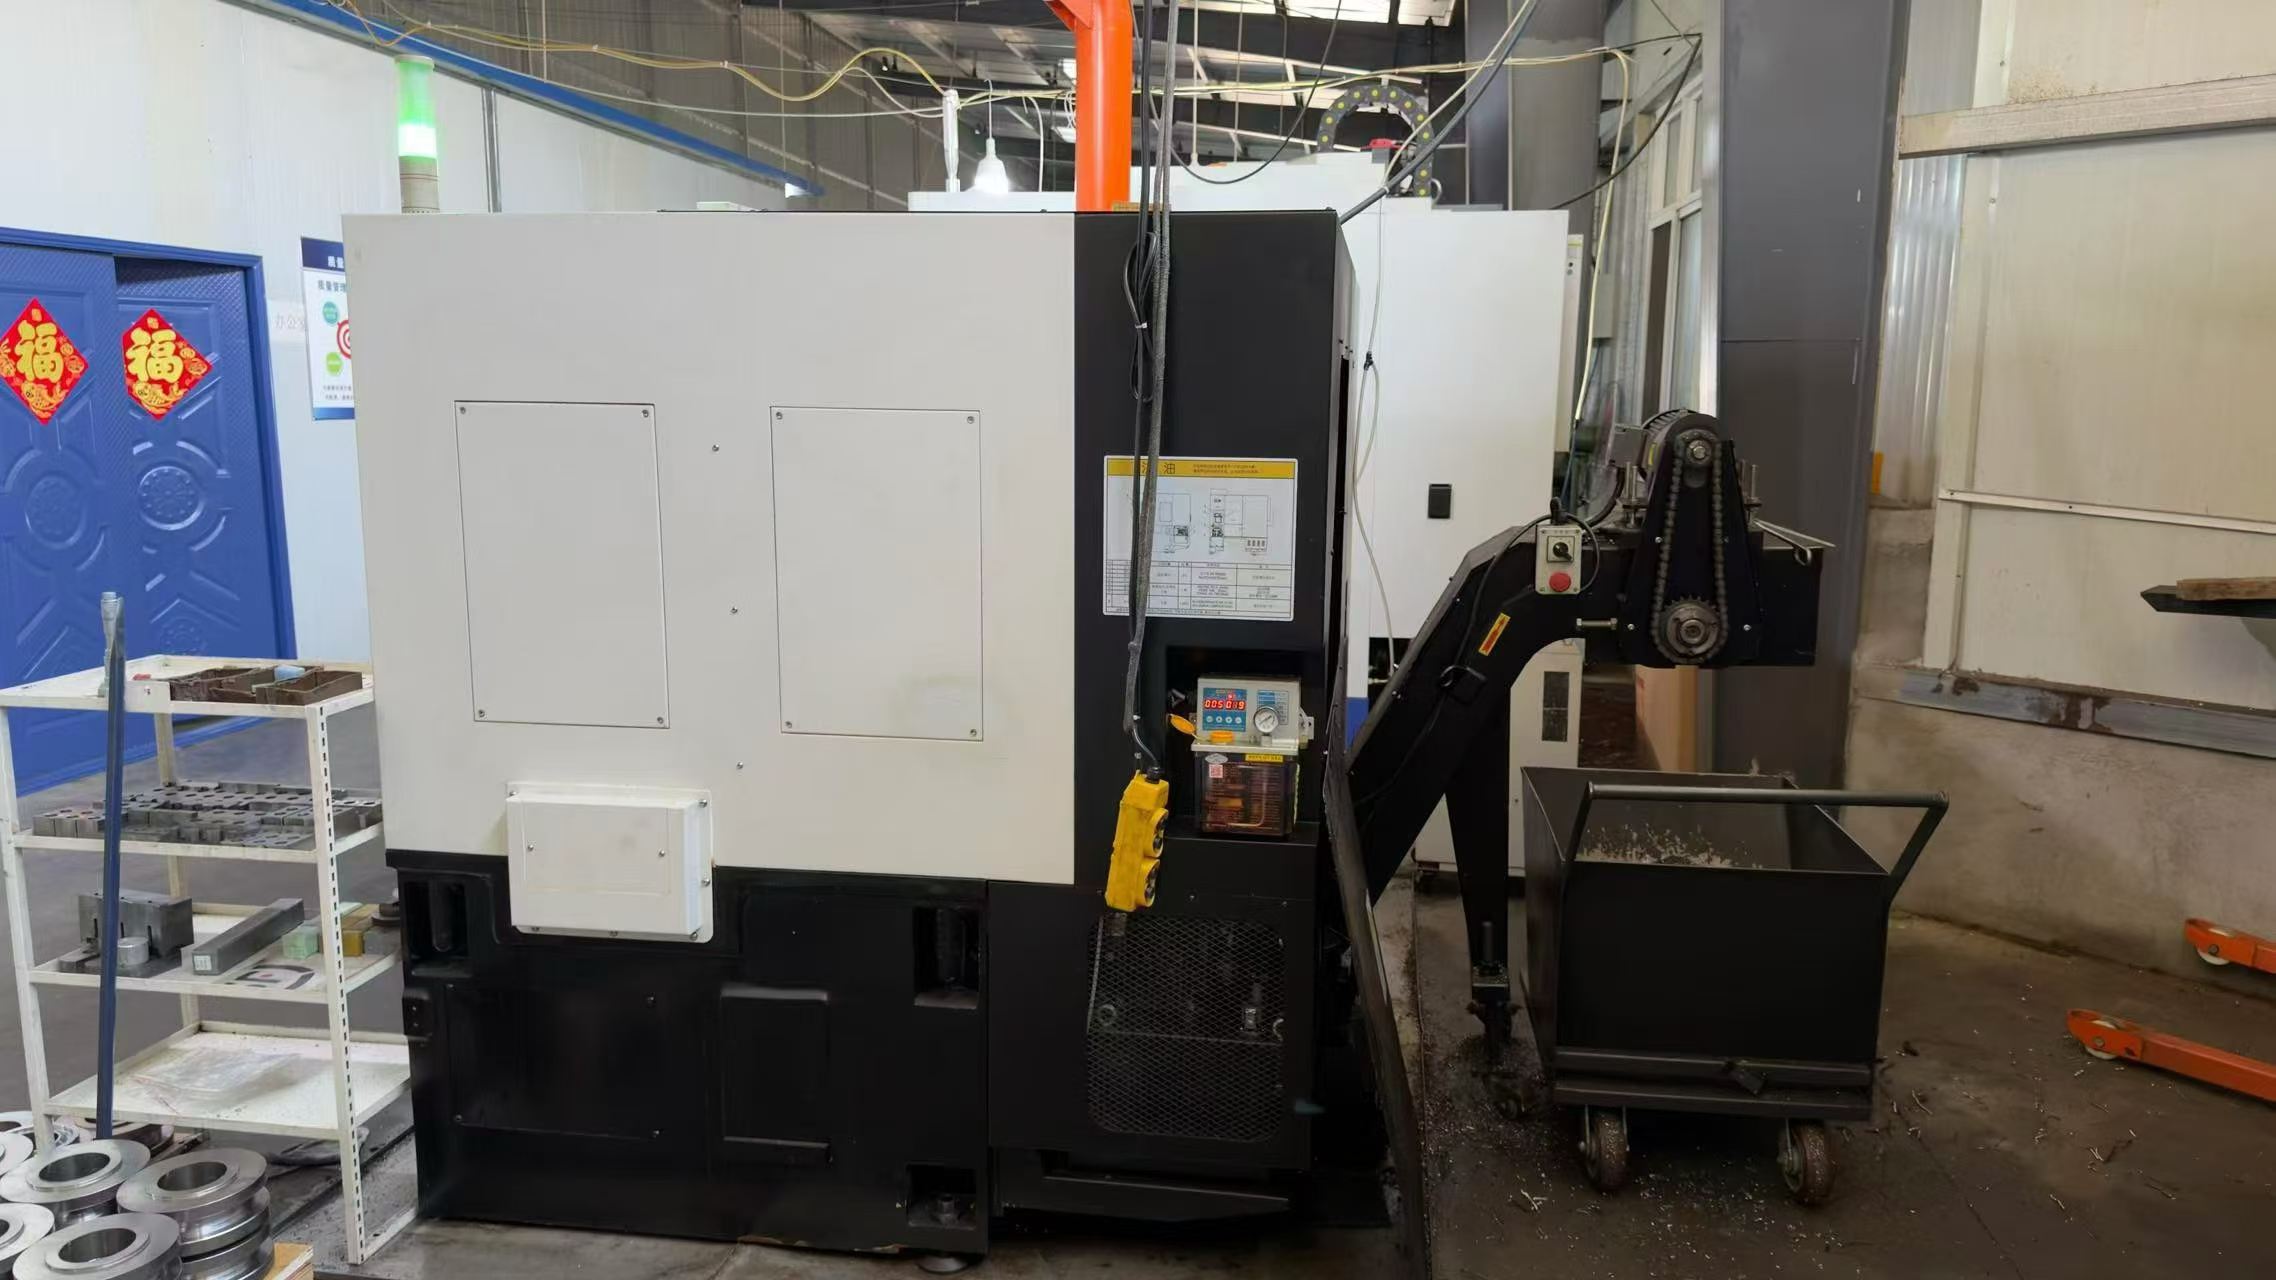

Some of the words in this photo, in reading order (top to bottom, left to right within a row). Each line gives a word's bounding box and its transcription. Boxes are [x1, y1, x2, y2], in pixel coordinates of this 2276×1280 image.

[15, 320, 64, 383] 福
[126, 328, 183, 383] 福
[1163, 462, 1176, 475] 油
